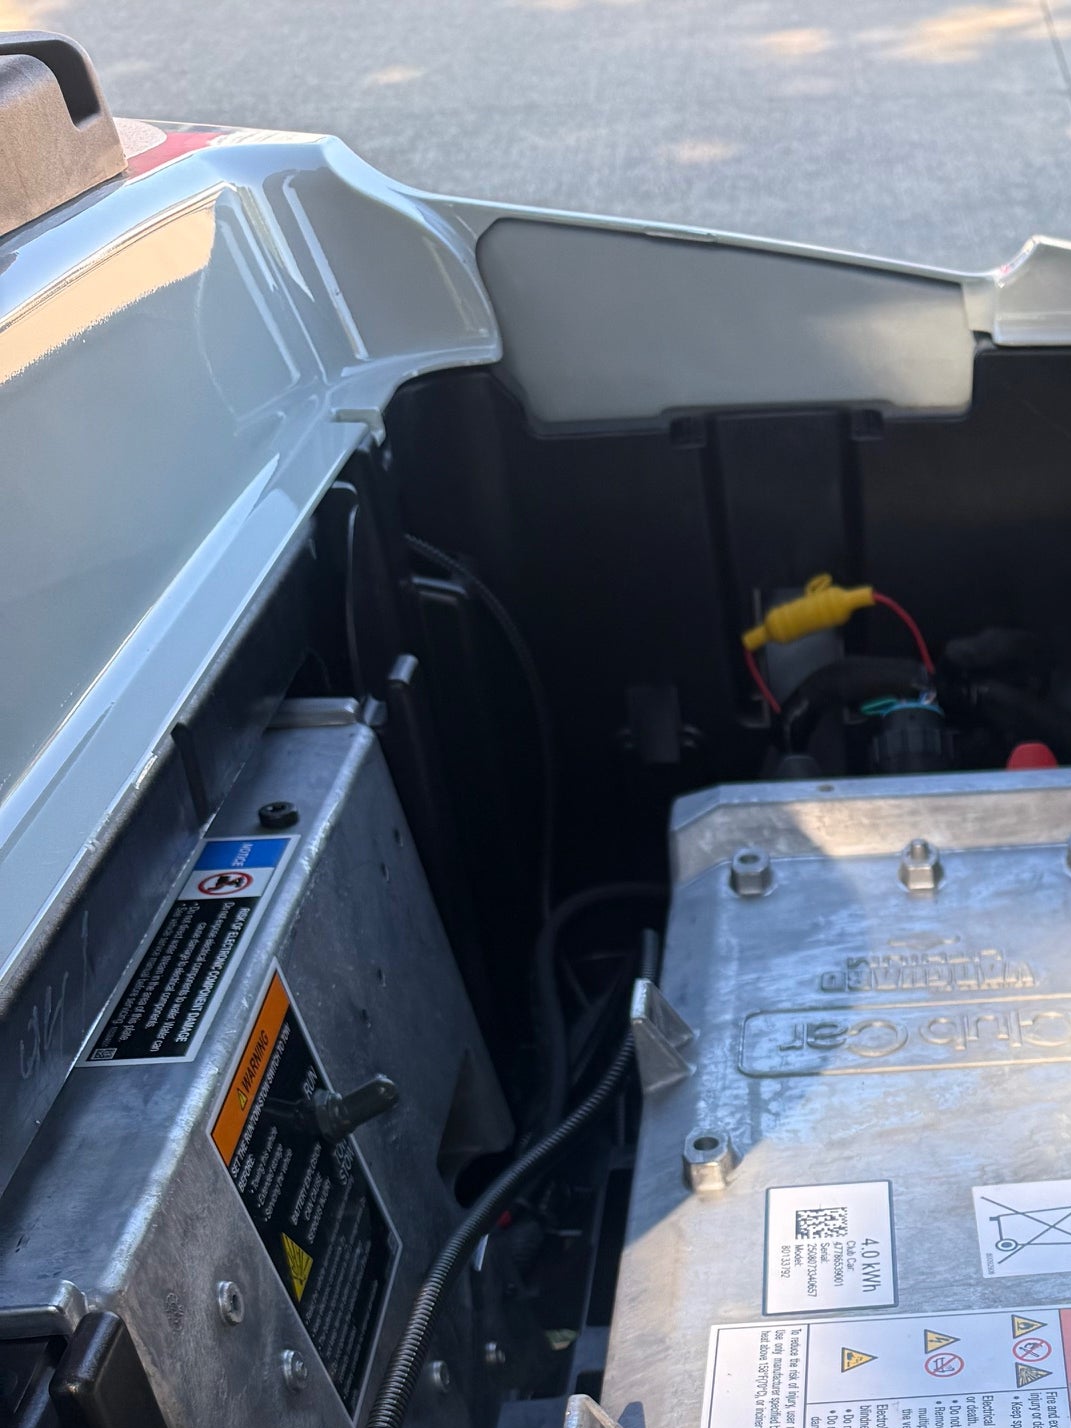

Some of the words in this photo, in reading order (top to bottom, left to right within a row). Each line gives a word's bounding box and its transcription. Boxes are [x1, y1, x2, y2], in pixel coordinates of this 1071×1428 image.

[233, 844, 252, 866] NOTICE
[236, 908, 249, 922] RISK
[212, 932, 237, 969] ELECTRONIC
[192, 971, 218, 1010] COMPONENT
[176, 1013, 198, 1041] DAMAGE
[778, 1019, 908, 1057] Car
[242, 1031, 268, 1091] WARNING
[304, 1066, 317, 1099] RUN
[232, 1158, 240, 1177] SET
[847, 1240, 856, 1256] Club
[862, 1238, 880, 1258] 4.0
[862, 1262, 881, 1292] kWh
[761, 1330, 771, 1342] heat
[775, 1329, 786, 1339] Use
[760, 1344, 770, 1360] above
[772, 1343, 785, 1354] only
[790, 1337, 800, 1356] reduce
[790, 1358, 800, 1367] the
[772, 1358, 783, 1395] manufacturer
[789, 1369, 800, 1380] risk
[785, 1391, 799, 1408] injury,
[1028, 1392, 1042, 1411] injury
[1046, 1392, 1058, 1403] Fire
[769, 1397, 781, 1424] specified
[787, 1410, 795, 1424] user
[902, 1409, 913, 1420] the
[950, 1405, 961, 1414] Do
[967, 1404, 979, 1426] death.
[983, 1395, 995, 1425] Electrical
[1010, 1401, 1023, 1418] Keep
[1048, 1405, 1060, 1418] and
[827, 1415, 838, 1424] Do
[843, 1414, 854, 1423] Do
[951, 1416, 962, 1427] not
